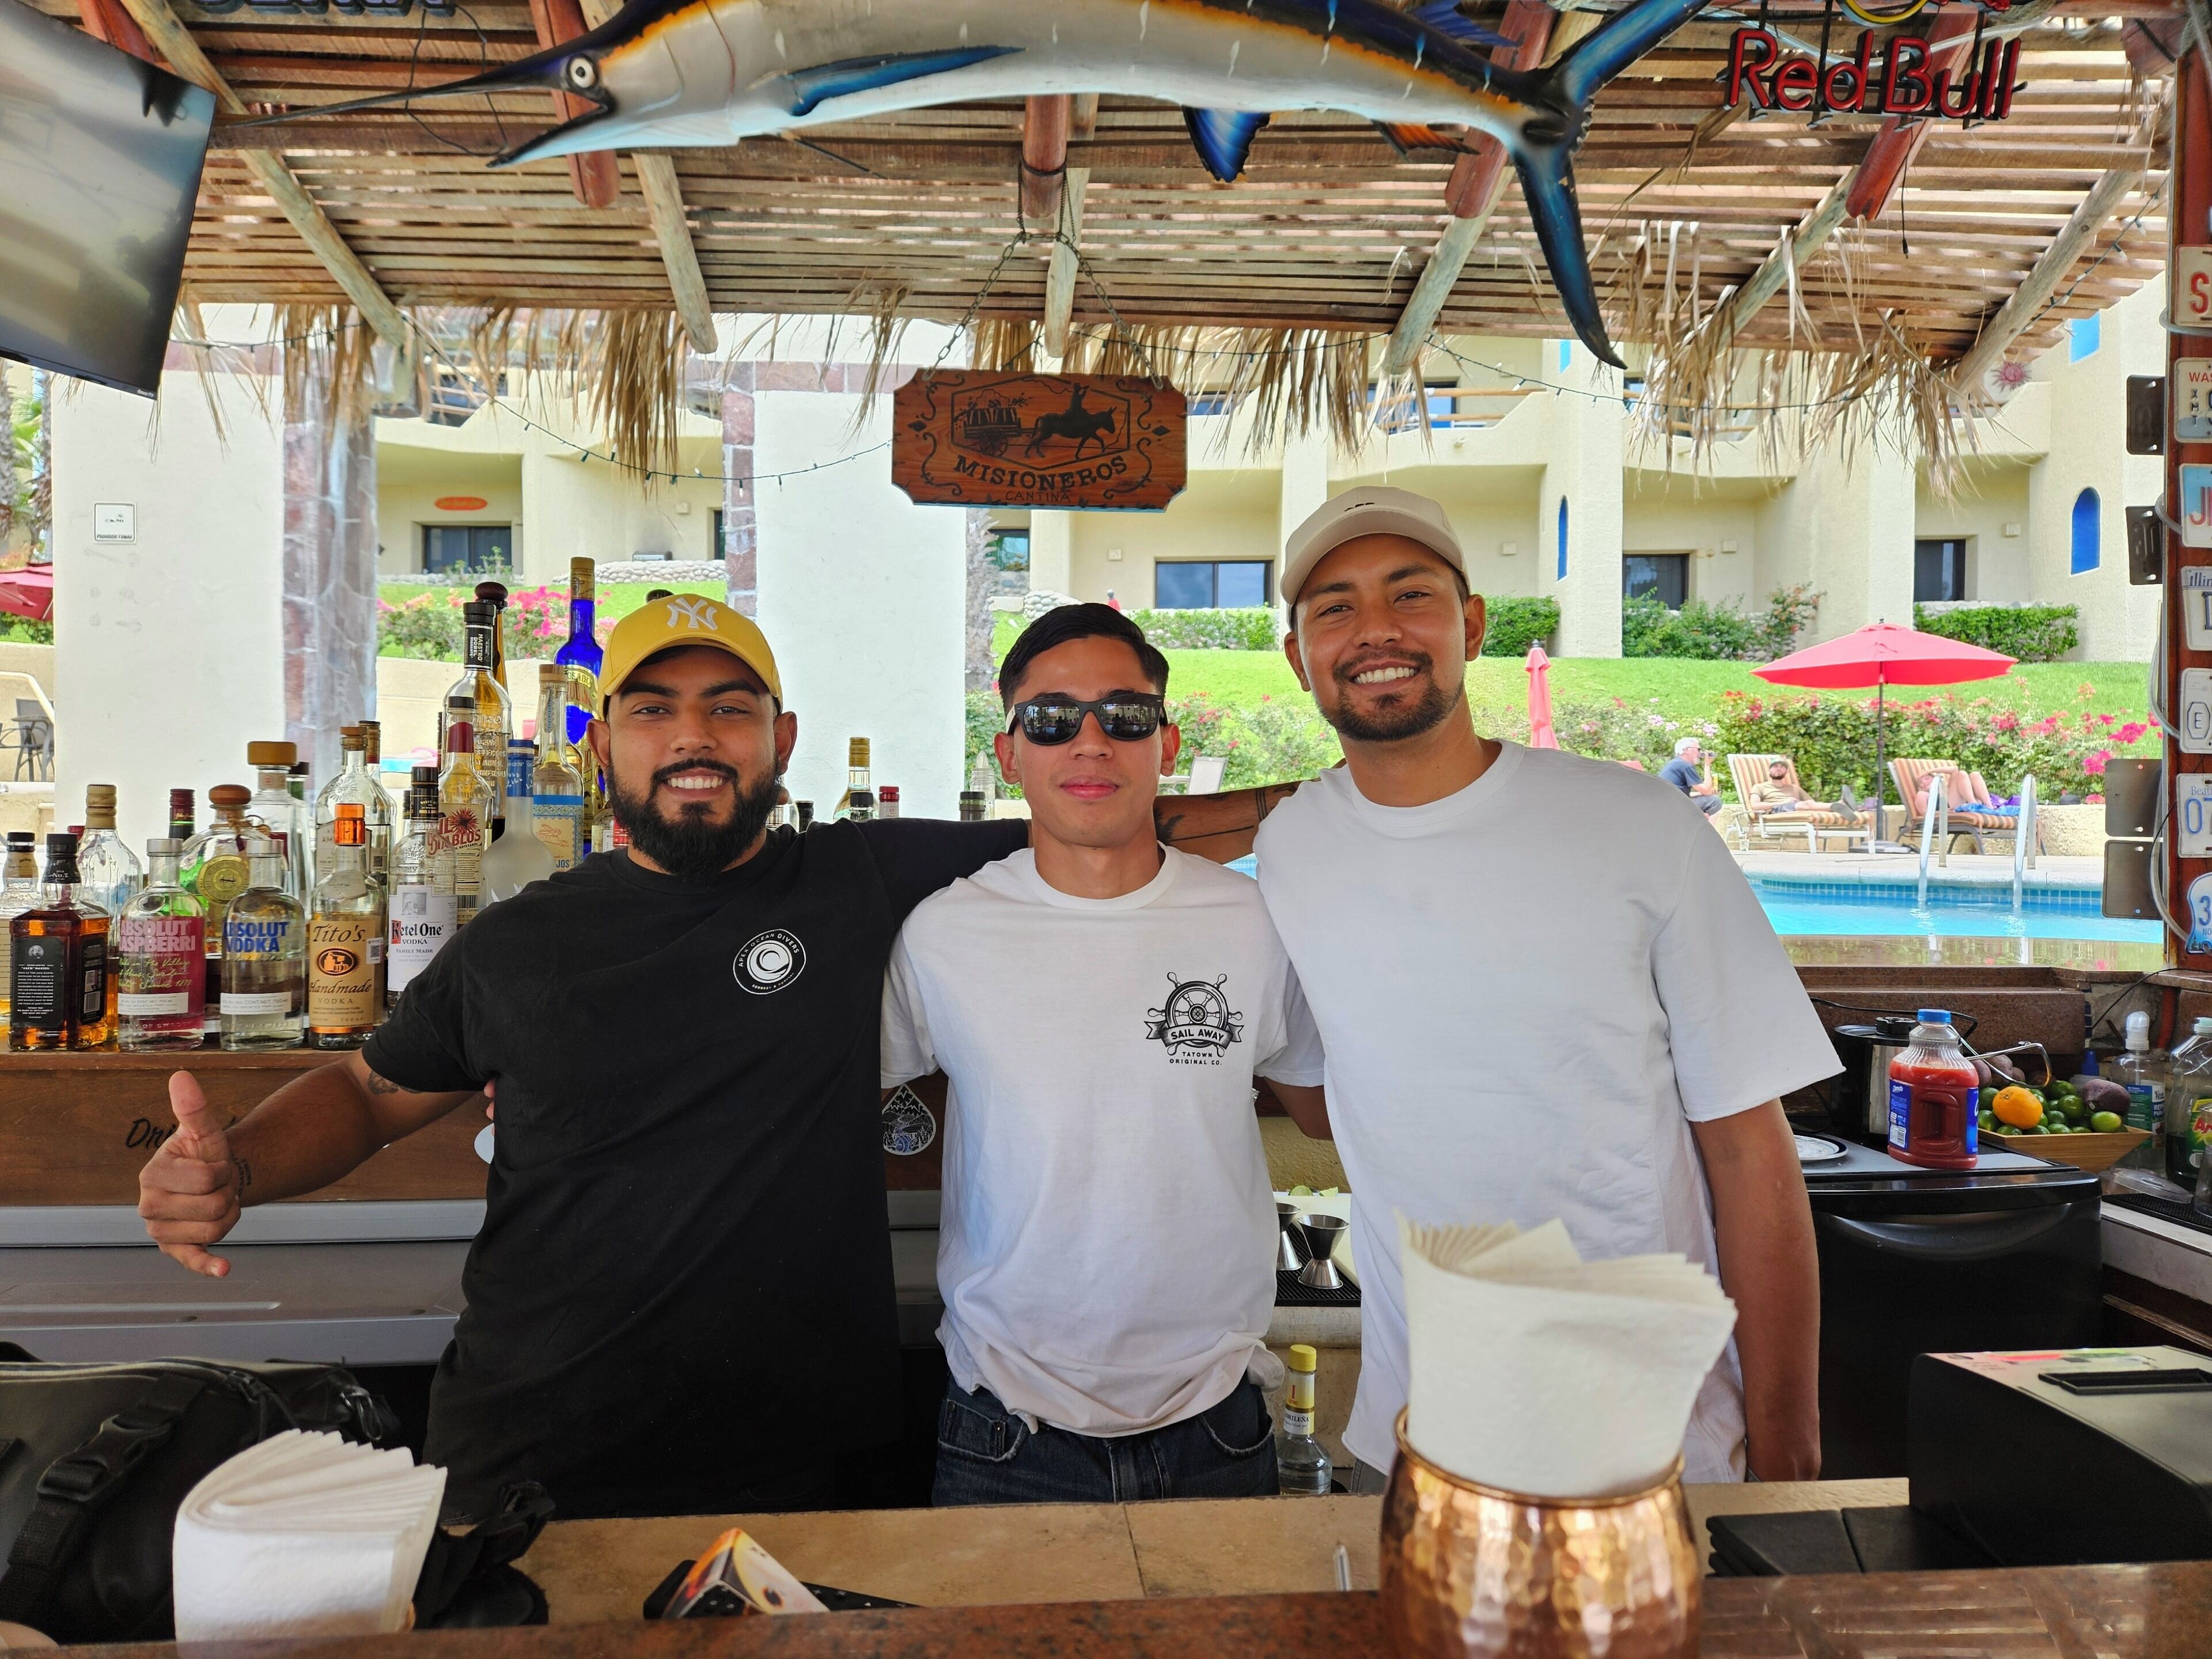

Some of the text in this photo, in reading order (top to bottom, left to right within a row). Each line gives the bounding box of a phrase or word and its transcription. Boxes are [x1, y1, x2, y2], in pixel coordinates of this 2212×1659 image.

[1729, 28, 2021, 119] Red Bull
[2189, 372, 2212, 382] WA
[953, 454, 1128, 491] MISIONEROS
[1005, 490, 1071, 503] CANTINA
[666, 597, 718, 630] NY
[2186, 798, 2212, 835] 0
[120, 920, 191, 937] ABSOLUT
[313, 924, 365, 942] Tito's
[392, 921, 443, 942] Ketel One
[226, 937, 281, 953] VODKA
[738, 933, 800, 967] APEX OCEAN DIVERS
[309, 979, 372, 994] Handmade
[1171, 1029, 1225, 1041] SAIL AWAY
